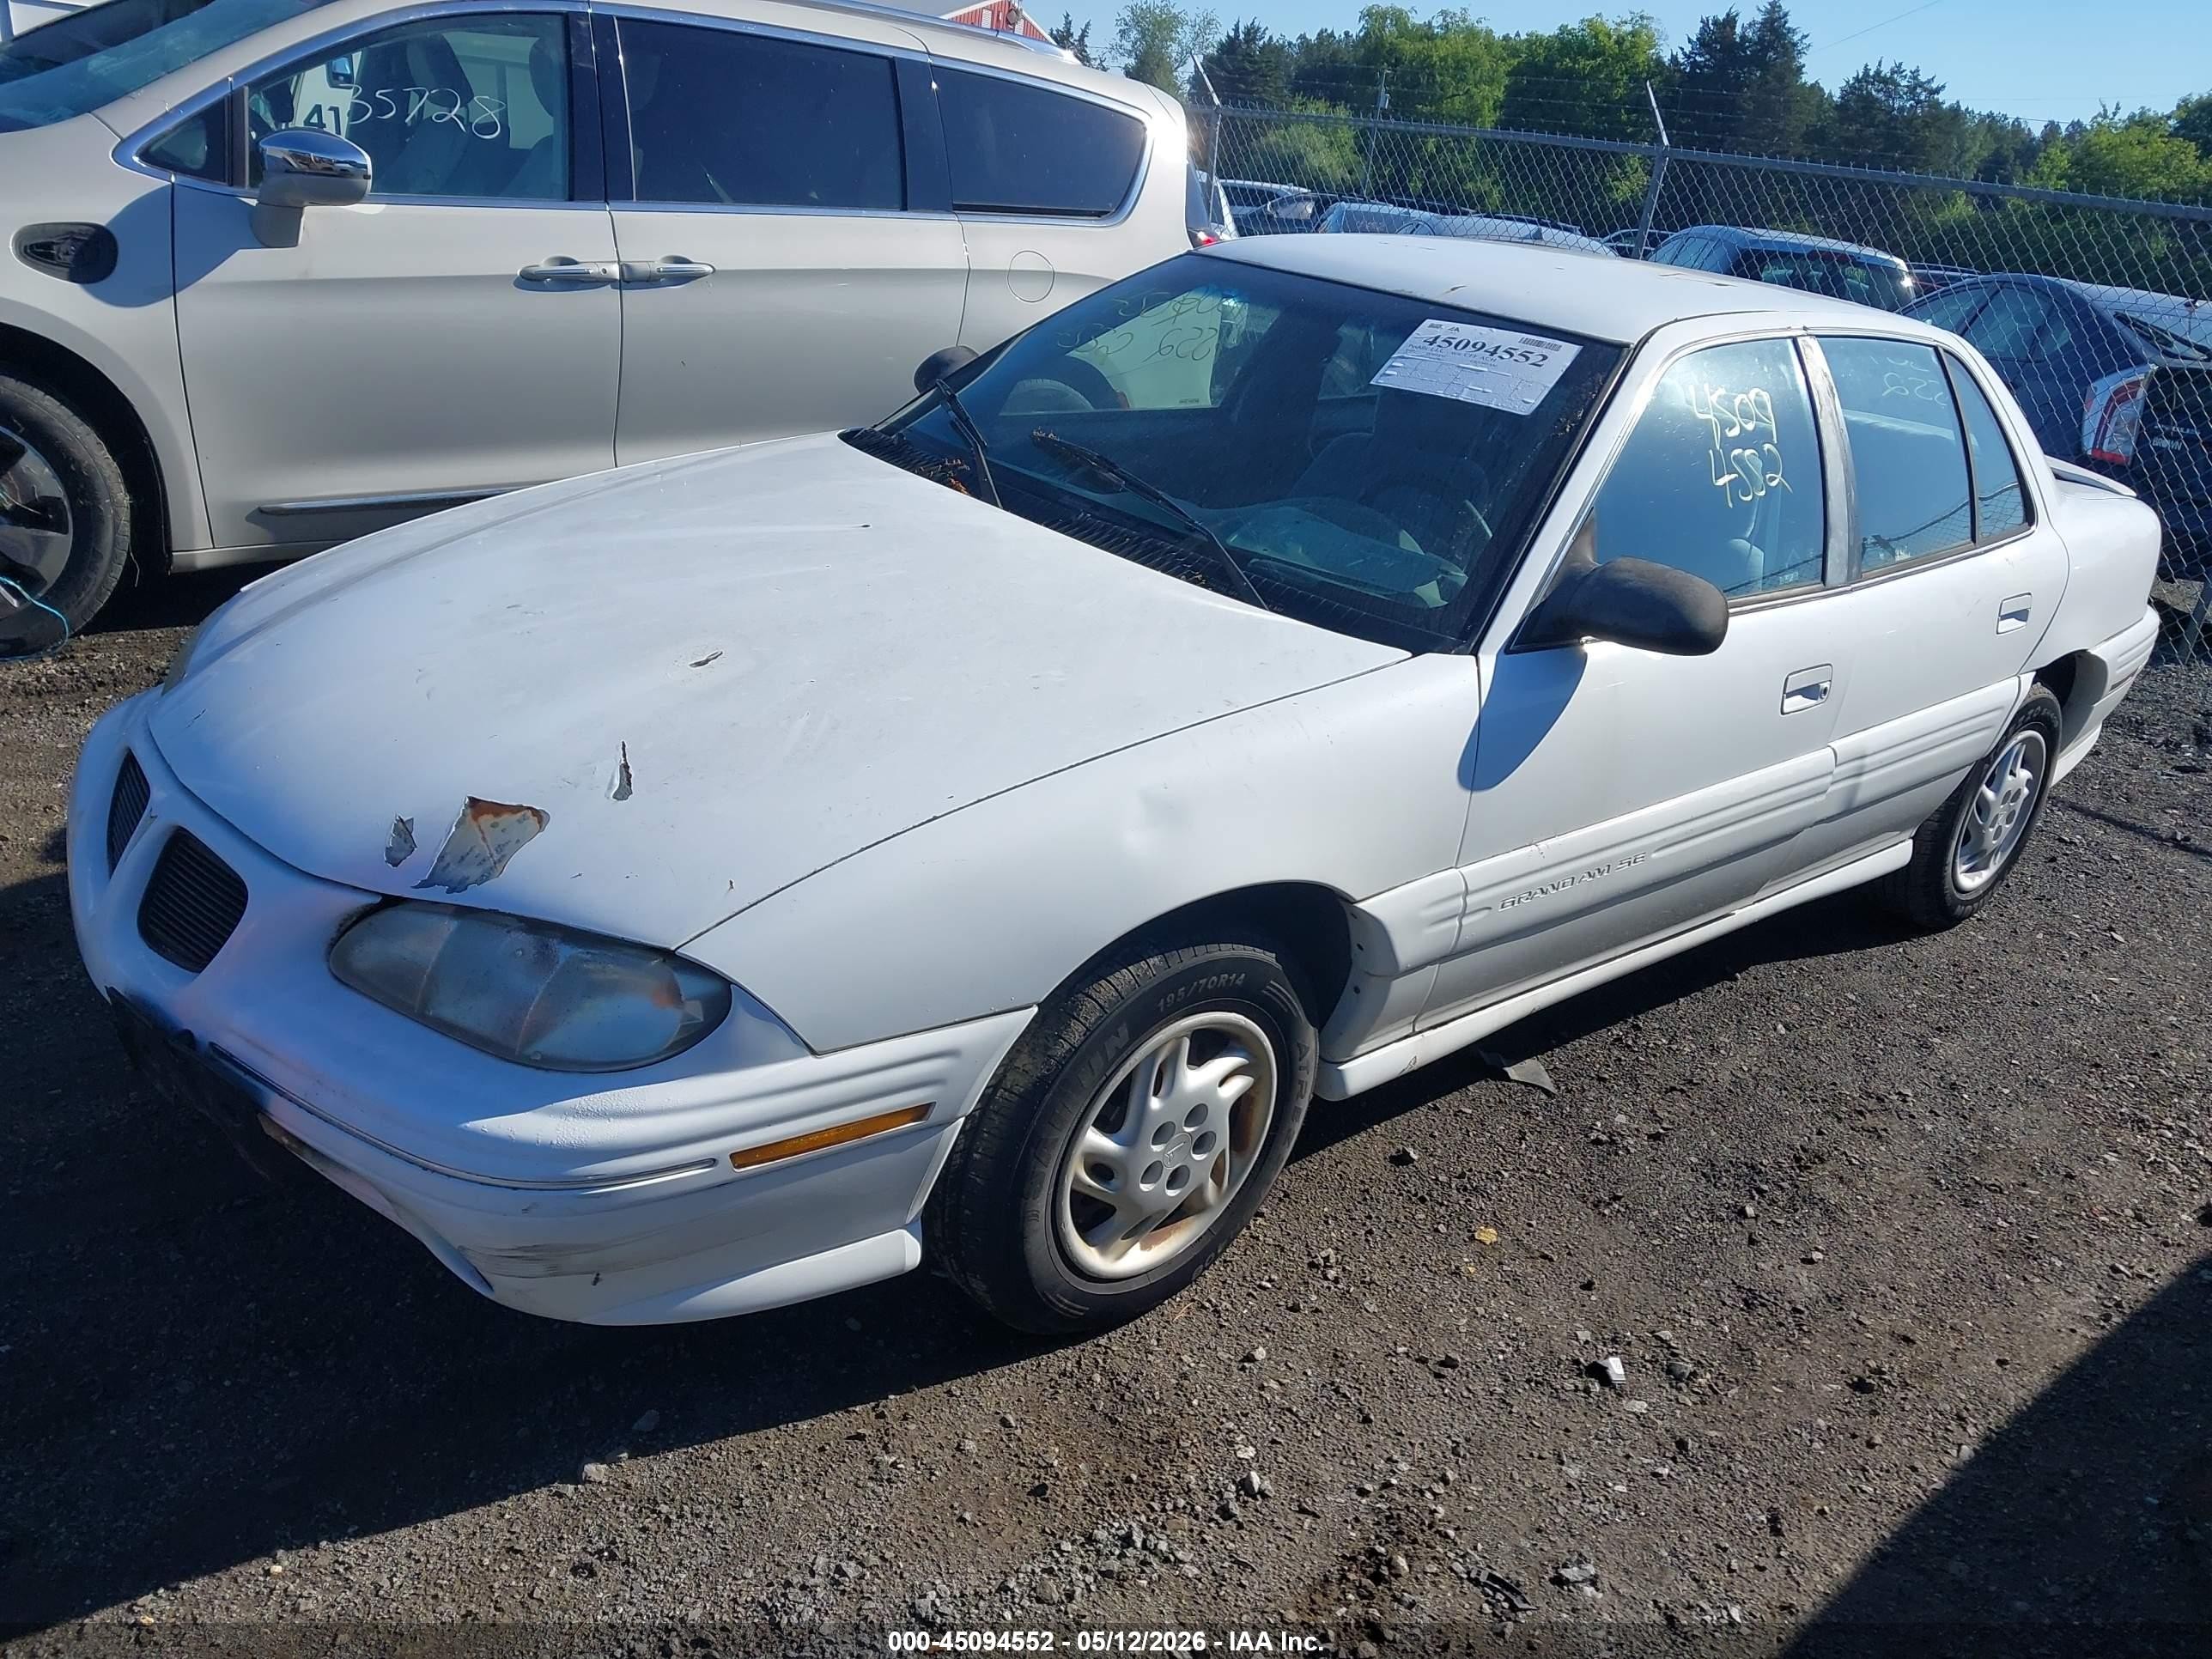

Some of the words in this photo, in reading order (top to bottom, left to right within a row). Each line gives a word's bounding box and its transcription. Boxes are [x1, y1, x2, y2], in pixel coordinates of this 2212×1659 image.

[338, 83, 506, 139] 35728
[1423, 334, 1549, 367] 45094552
[1688, 383, 1778, 451] 4509
[1498, 876, 1575, 912] GRAND
[1577, 864, 1611, 885] AM
[1614, 852, 1646, 872] SE
[1158, 972, 1246, 1013] 195/70R14
